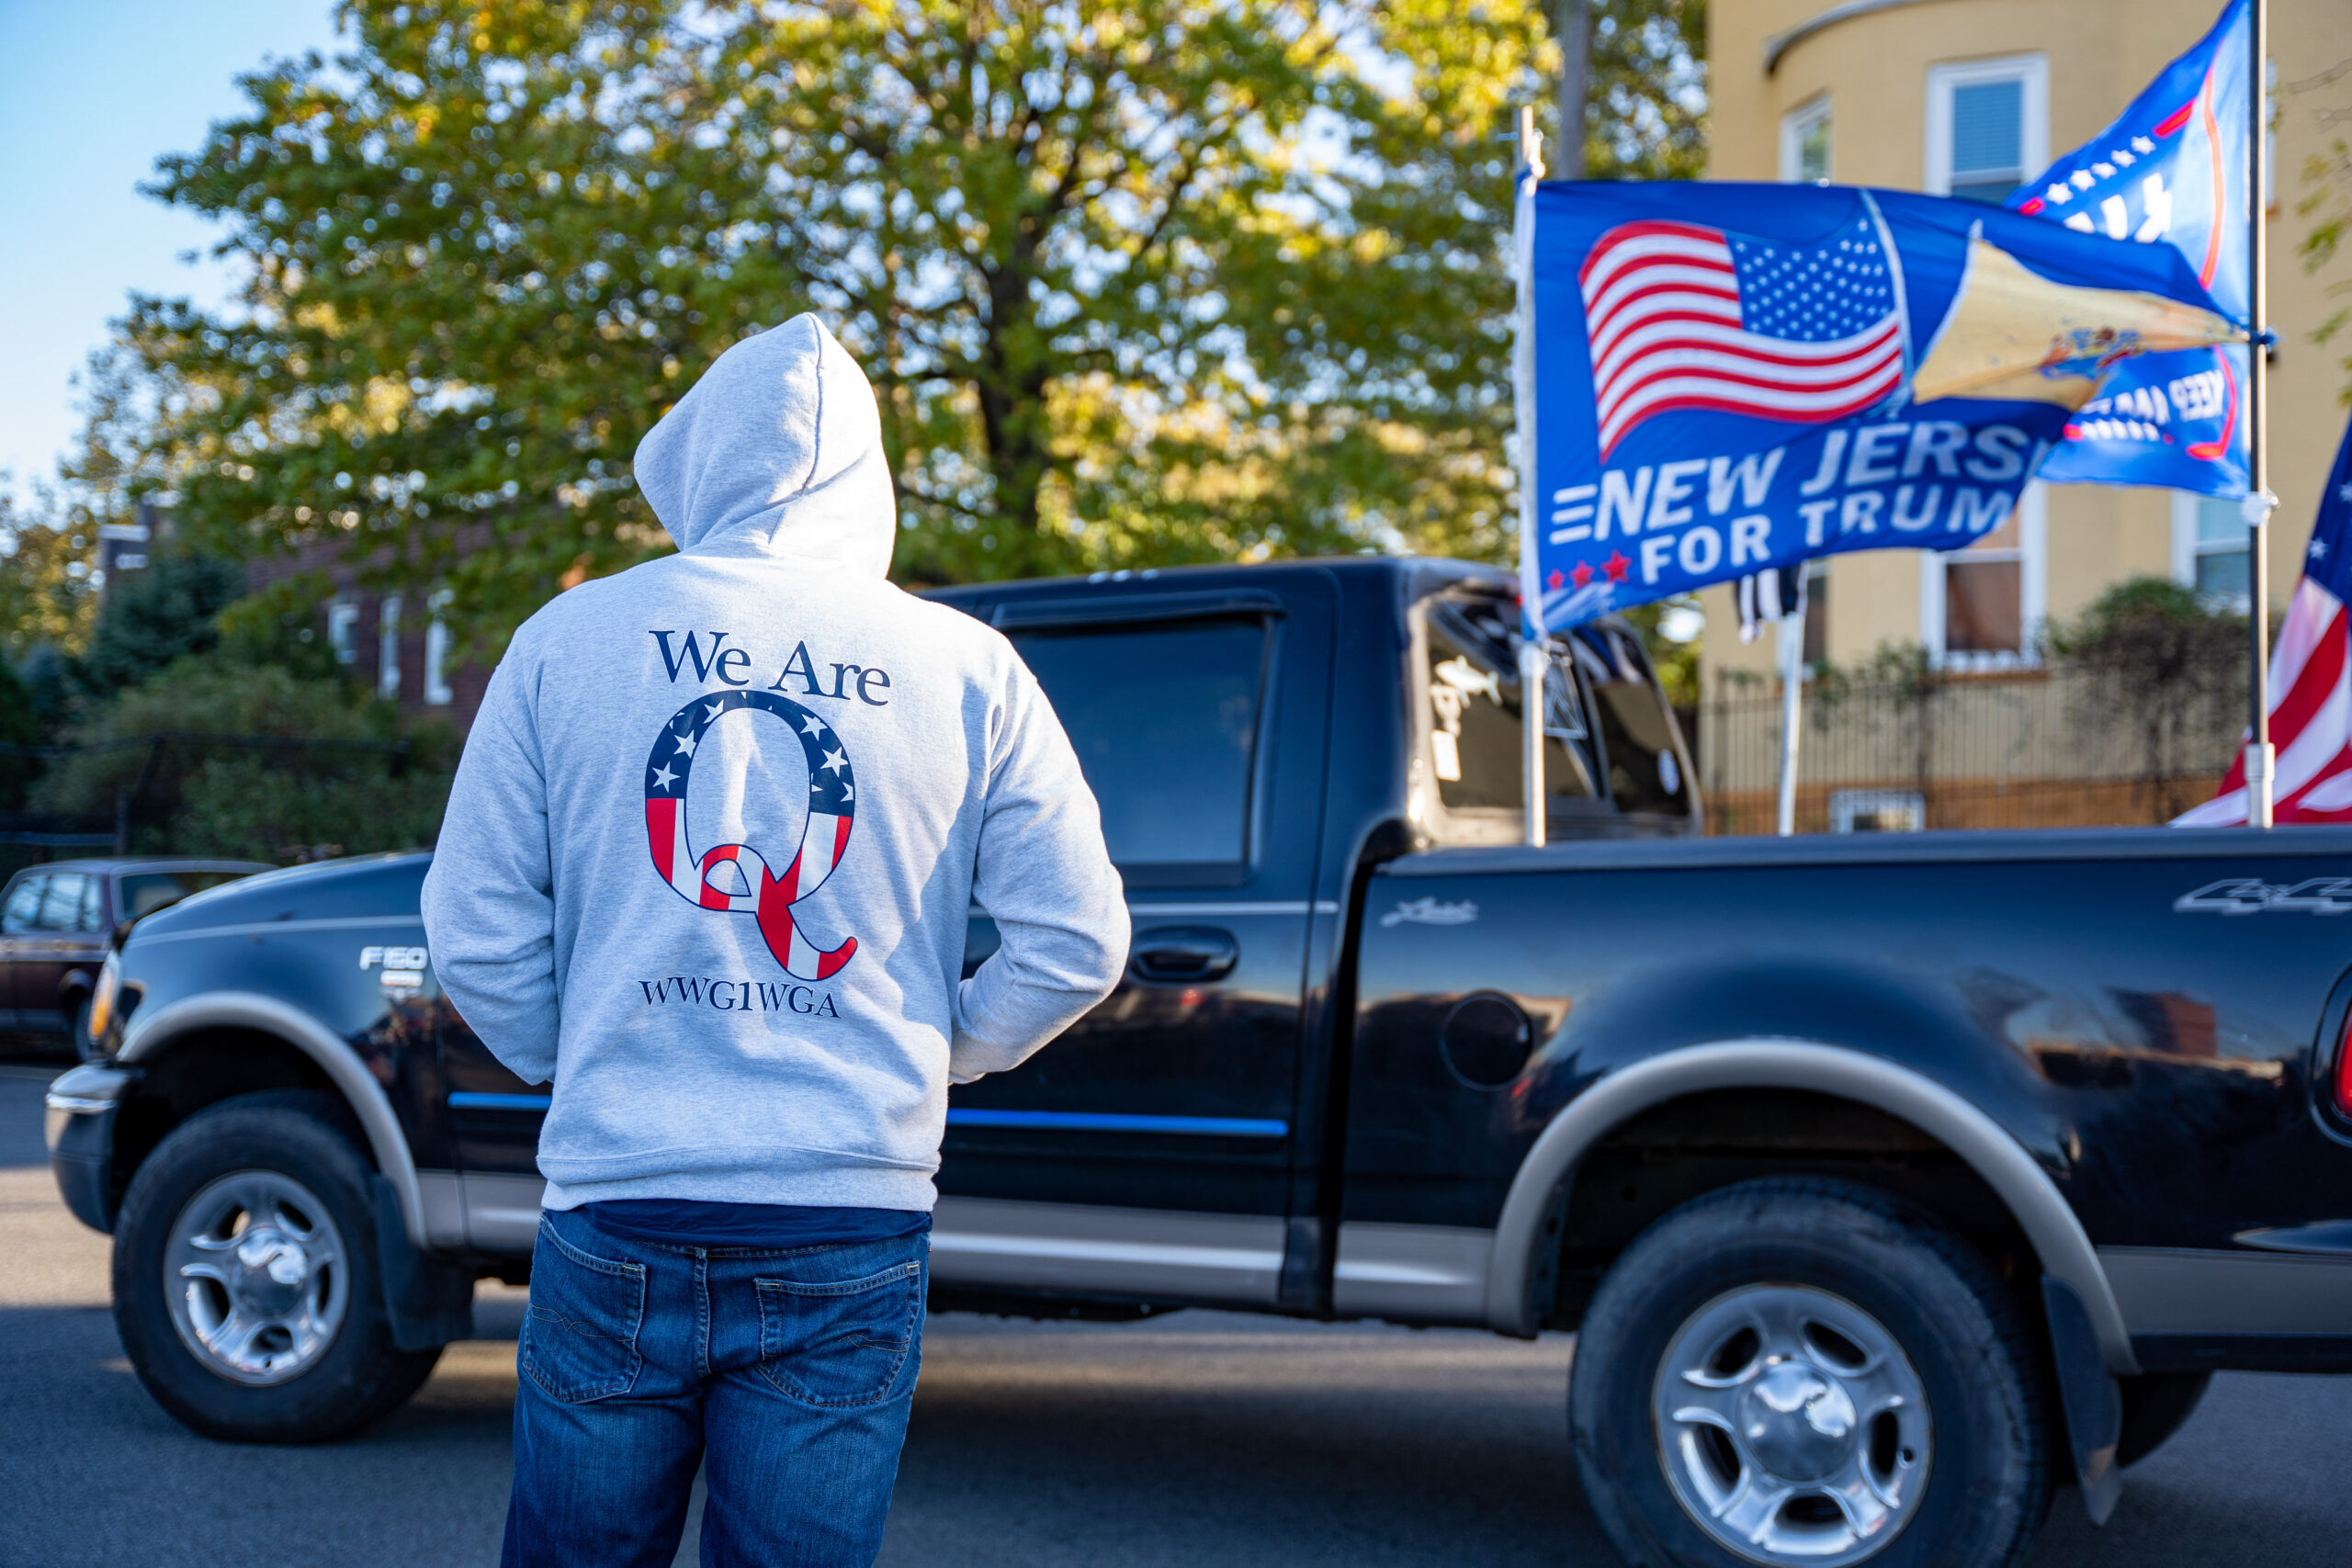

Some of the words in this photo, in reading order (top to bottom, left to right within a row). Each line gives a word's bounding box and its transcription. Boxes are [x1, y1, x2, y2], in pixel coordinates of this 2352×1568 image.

[1594, 447, 1786, 542] NEW
[1800, 421, 2048, 496] JERS
[1640, 514, 1772, 585] FOR
[649, 629, 752, 686] We
[767, 640, 891, 706] Are
[645, 689, 858, 982] Q
[638, 976, 842, 1019] WWG1WGA
